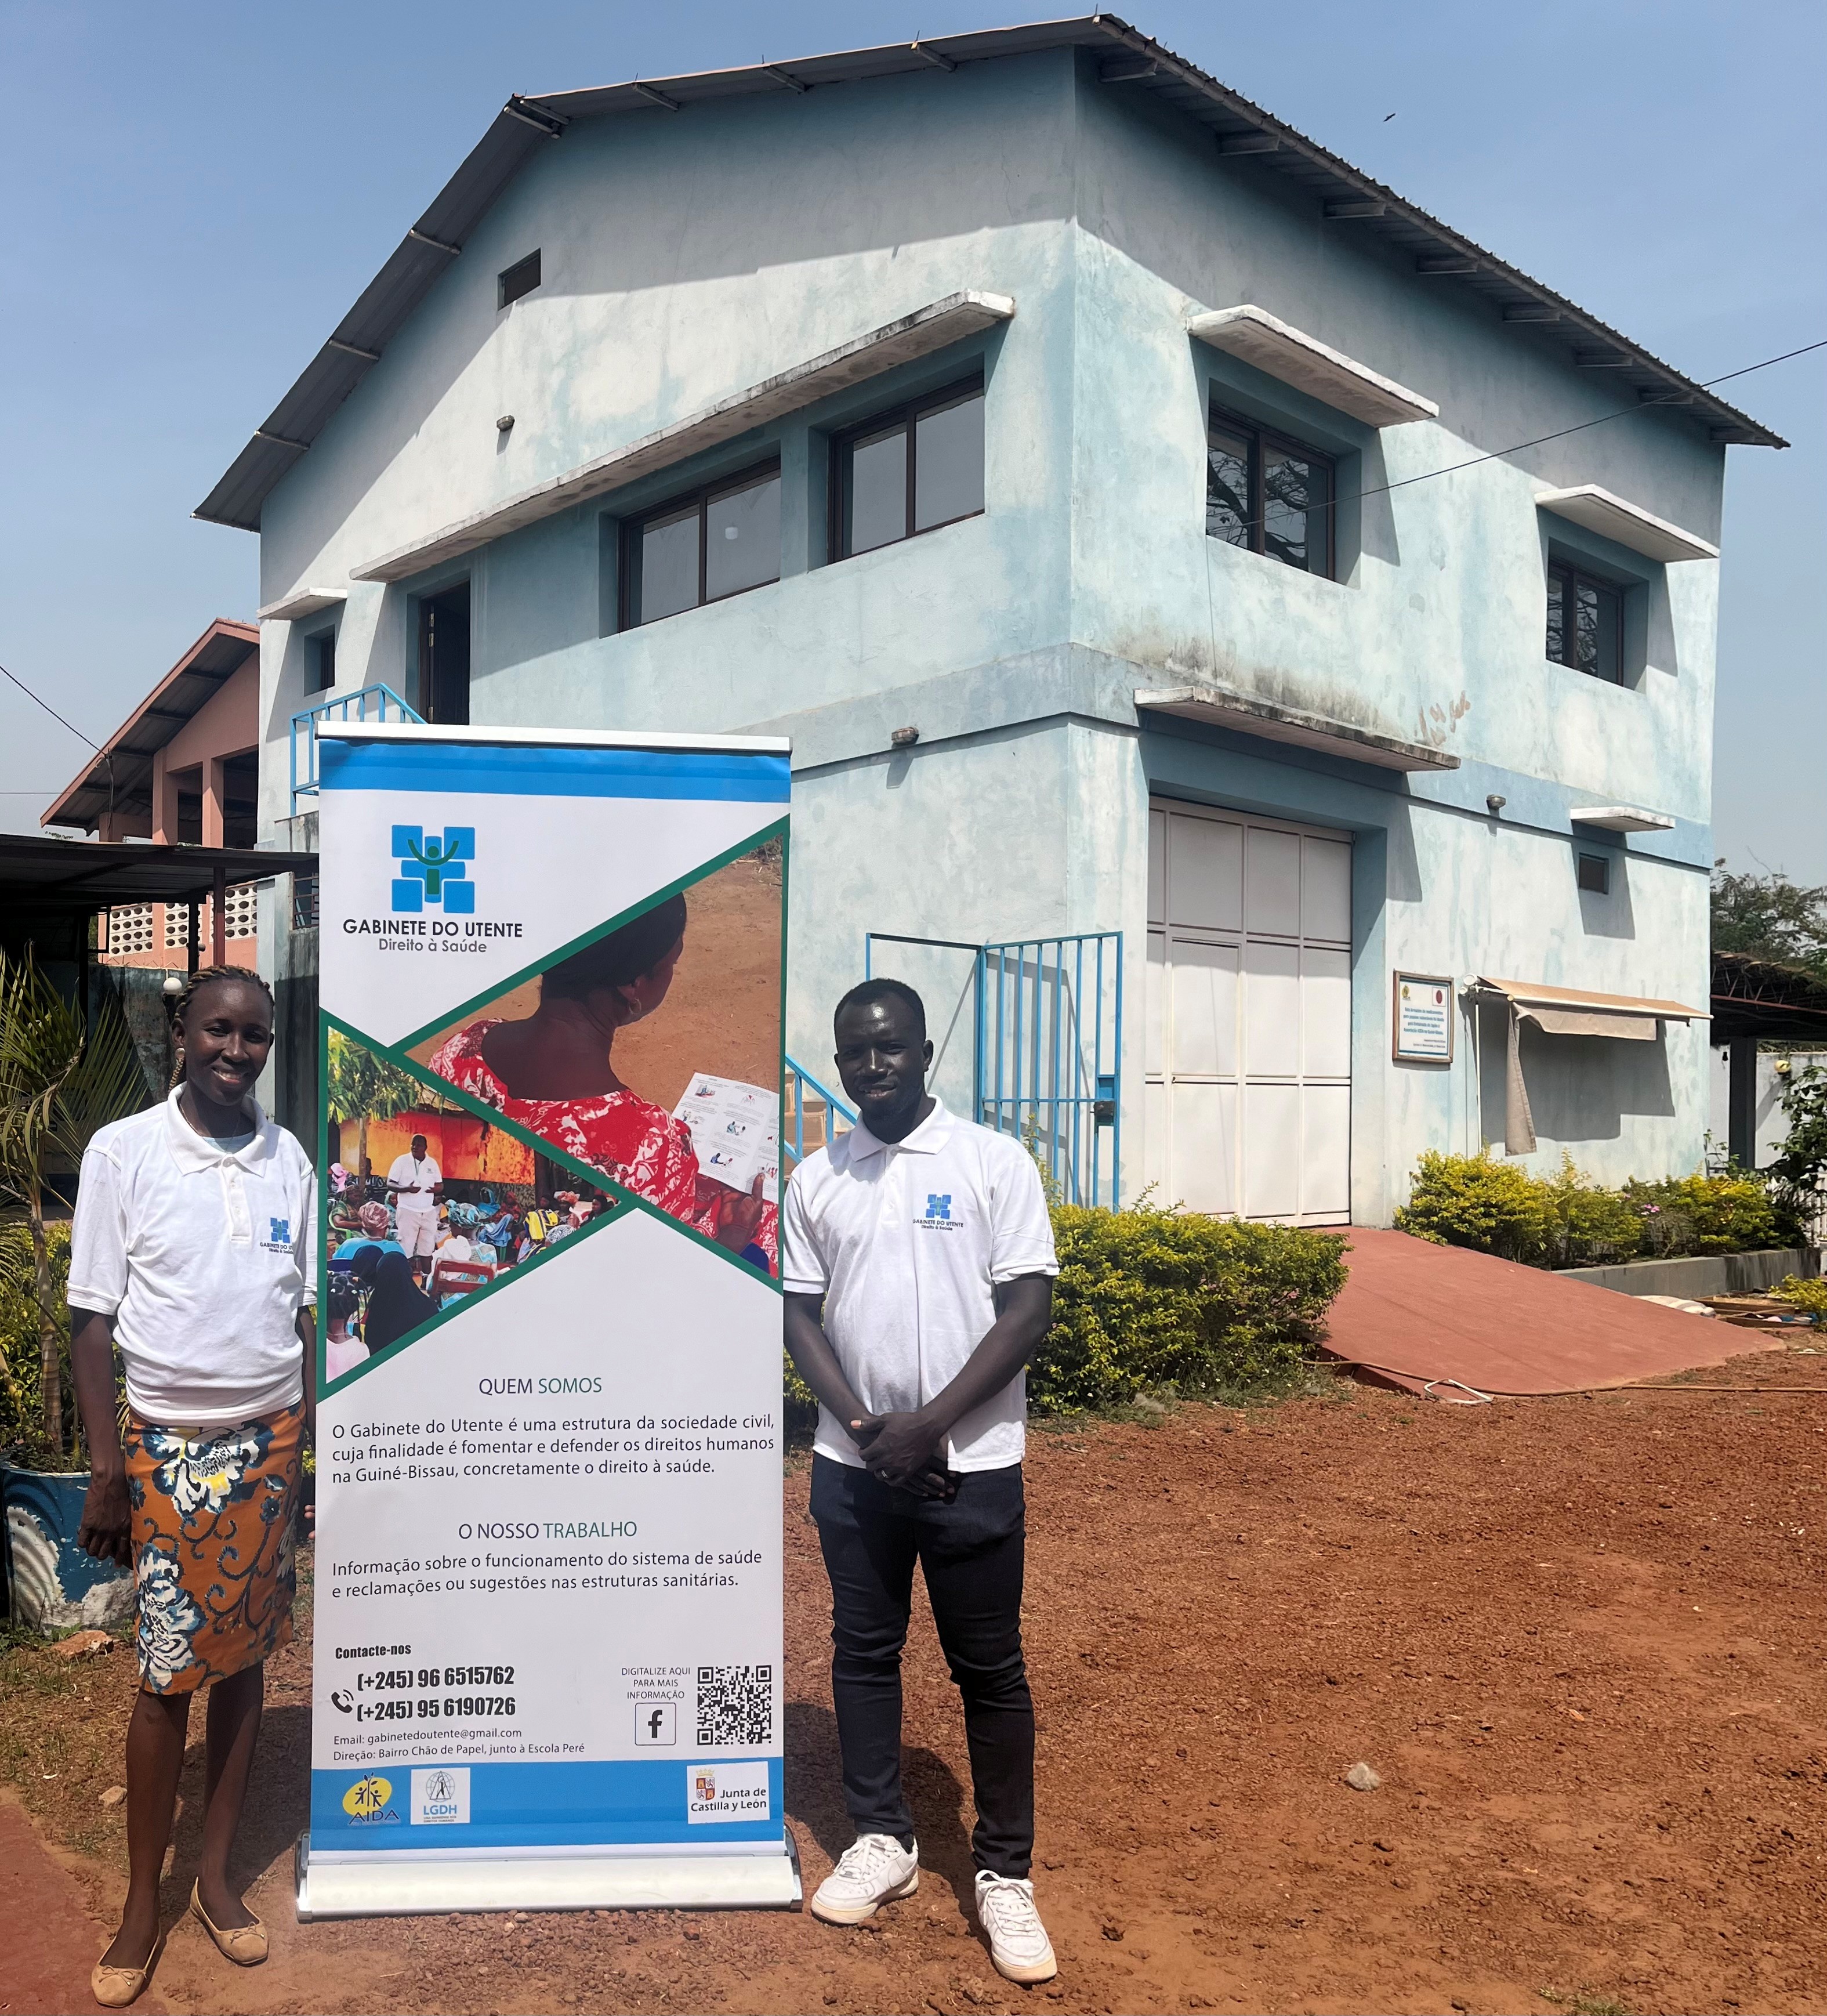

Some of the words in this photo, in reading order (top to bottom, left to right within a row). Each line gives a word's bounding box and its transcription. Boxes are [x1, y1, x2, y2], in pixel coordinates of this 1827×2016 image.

[343, 918, 426, 936] GABINETE
[432, 921, 459, 936] DO
[465, 922, 523, 938] UTENTE
[379, 938, 423, 951] Direito
[427, 938, 437, 952] à
[441, 939, 487, 953] Saúde
[479, 1378, 532, 1396] QUEM
[538, 1377, 602, 1394] SOMOS
[332, 1425, 345, 1439] O
[350, 1422, 420, 1438] Gabinete
[426, 1419, 445, 1434] do
[451, 1418, 503, 1432] Utente
[509, 1417, 517, 1431] é
[524, 1421, 556, 1431] uma
[562, 1417, 630, 1431] estrutura
[637, 1415, 654, 1429] da
[661, 1414, 737, 1429] sociedade
[742, 1413, 774, 1429] civil,
[332, 1446, 364, 1464] cuja
[368, 1441, 444, 1459] finalidade
[448, 1440, 457, 1454] é
[461, 1439, 533, 1454] fomentar
[537, 1443, 546, 1453] e
[550, 1438, 619, 1453] defender
[624, 1440, 640, 1452] os
[644, 1437, 702, 1451] direitos
[706, 1436, 774, 1451] humanos
[332, 1472, 350, 1483] na
[356, 1464, 458, 1482] Guiné-Bissau,
[463, 1462, 580, 1475] concretamente
[585, 1464, 594, 1474] o
[599, 1459, 648, 1474] direito
[653, 1459, 661, 1473] à
[666, 1458, 715, 1473] saúde.
[458, 1523, 472, 1540] O
[478, 1523, 539, 1539] NOSSO
[542, 1521, 637, 1539] TRABALHO
[333, 1558, 420, 1576] Informação
[425, 1555, 467, 1570] sobre
[472, 1557, 481, 1568] o
[485, 1552, 603, 1568] funcionamento
[608, 1551, 628, 1566] do
[632, 1551, 690, 1565] sistema
[694, 1550, 713, 1565] de
[718, 1549, 762, 1565] saúde
[332, 1587, 341, 1598] e
[346, 1579, 441, 1597] reclamações
[445, 1580, 464, 1591] ou
[470, 1576, 546, 1592] sugestões
[552, 1578, 577, 1589] nas
[582, 1575, 658, 1588] estruturas
[663, 1572, 738, 1587] sanitárias.
[335, 1645, 411, 1659] Contacte-nos
[357, 1670, 414, 1692] (+245)
[418, 1668, 440, 1688] 96
[444, 1666, 514, 1686] 6515762
[621, 1667, 667, 1676] DIGITALIZE
[669, 1667, 690, 1676] AQUI
[633, 1679, 655, 1688] PARA
[657, 1679, 679, 1687] MAIS
[627, 1689, 685, 1701] INFORMAÇÃO
[357, 1700, 413, 1722] (+245)
[417, 1699, 440, 1718] 95
[444, 1696, 516, 1717] 6190726
[334, 1734, 365, 1745] Email:
[367, 1728, 522, 1746] gabinetedoutente@gmail.com
[334, 1750, 376, 1762] Direção:
[379, 1749, 409, 1758] Bairro
[411, 1746, 438, 1756] Chão
[440, 1744, 454, 1754] de
[456, 1744, 487, 1756] Papel,
[488, 1744, 517, 1756] junto
[519, 1743, 525, 1753] à
[528, 1743, 560, 1753] Escola
[563, 1743, 585, 1753] Peré
[720, 1789, 750, 1798] Junta
[753, 1787, 767, 1797] de
[423, 1804, 457, 1815] LGDH
[691, 1801, 729, 1812] Castilla
[731, 1802, 738, 1812] y
[741, 1799, 767, 1809] León
[349, 1809, 400, 1825] AIDA
